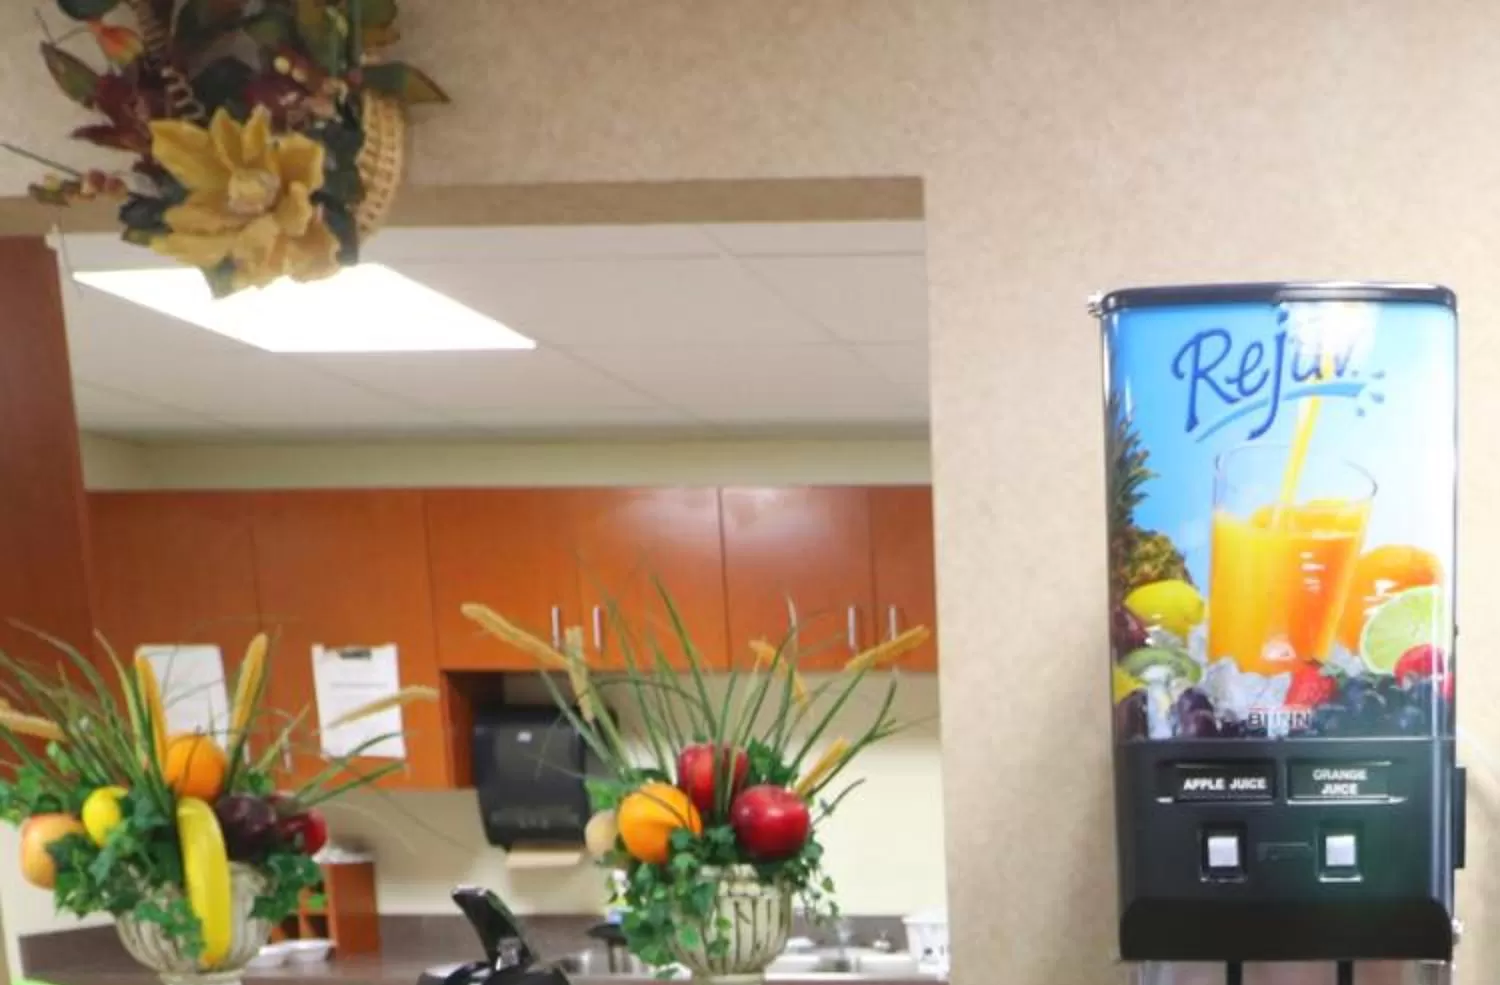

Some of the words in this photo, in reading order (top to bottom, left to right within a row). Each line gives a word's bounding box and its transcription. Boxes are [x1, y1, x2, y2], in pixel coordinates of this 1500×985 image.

[1312, 768, 1367, 781] ORANGE
[1183, 777, 1225, 791] APPLE
[1229, 777, 1267, 790] JUICE
[1321, 783, 1358, 796] JUICE
